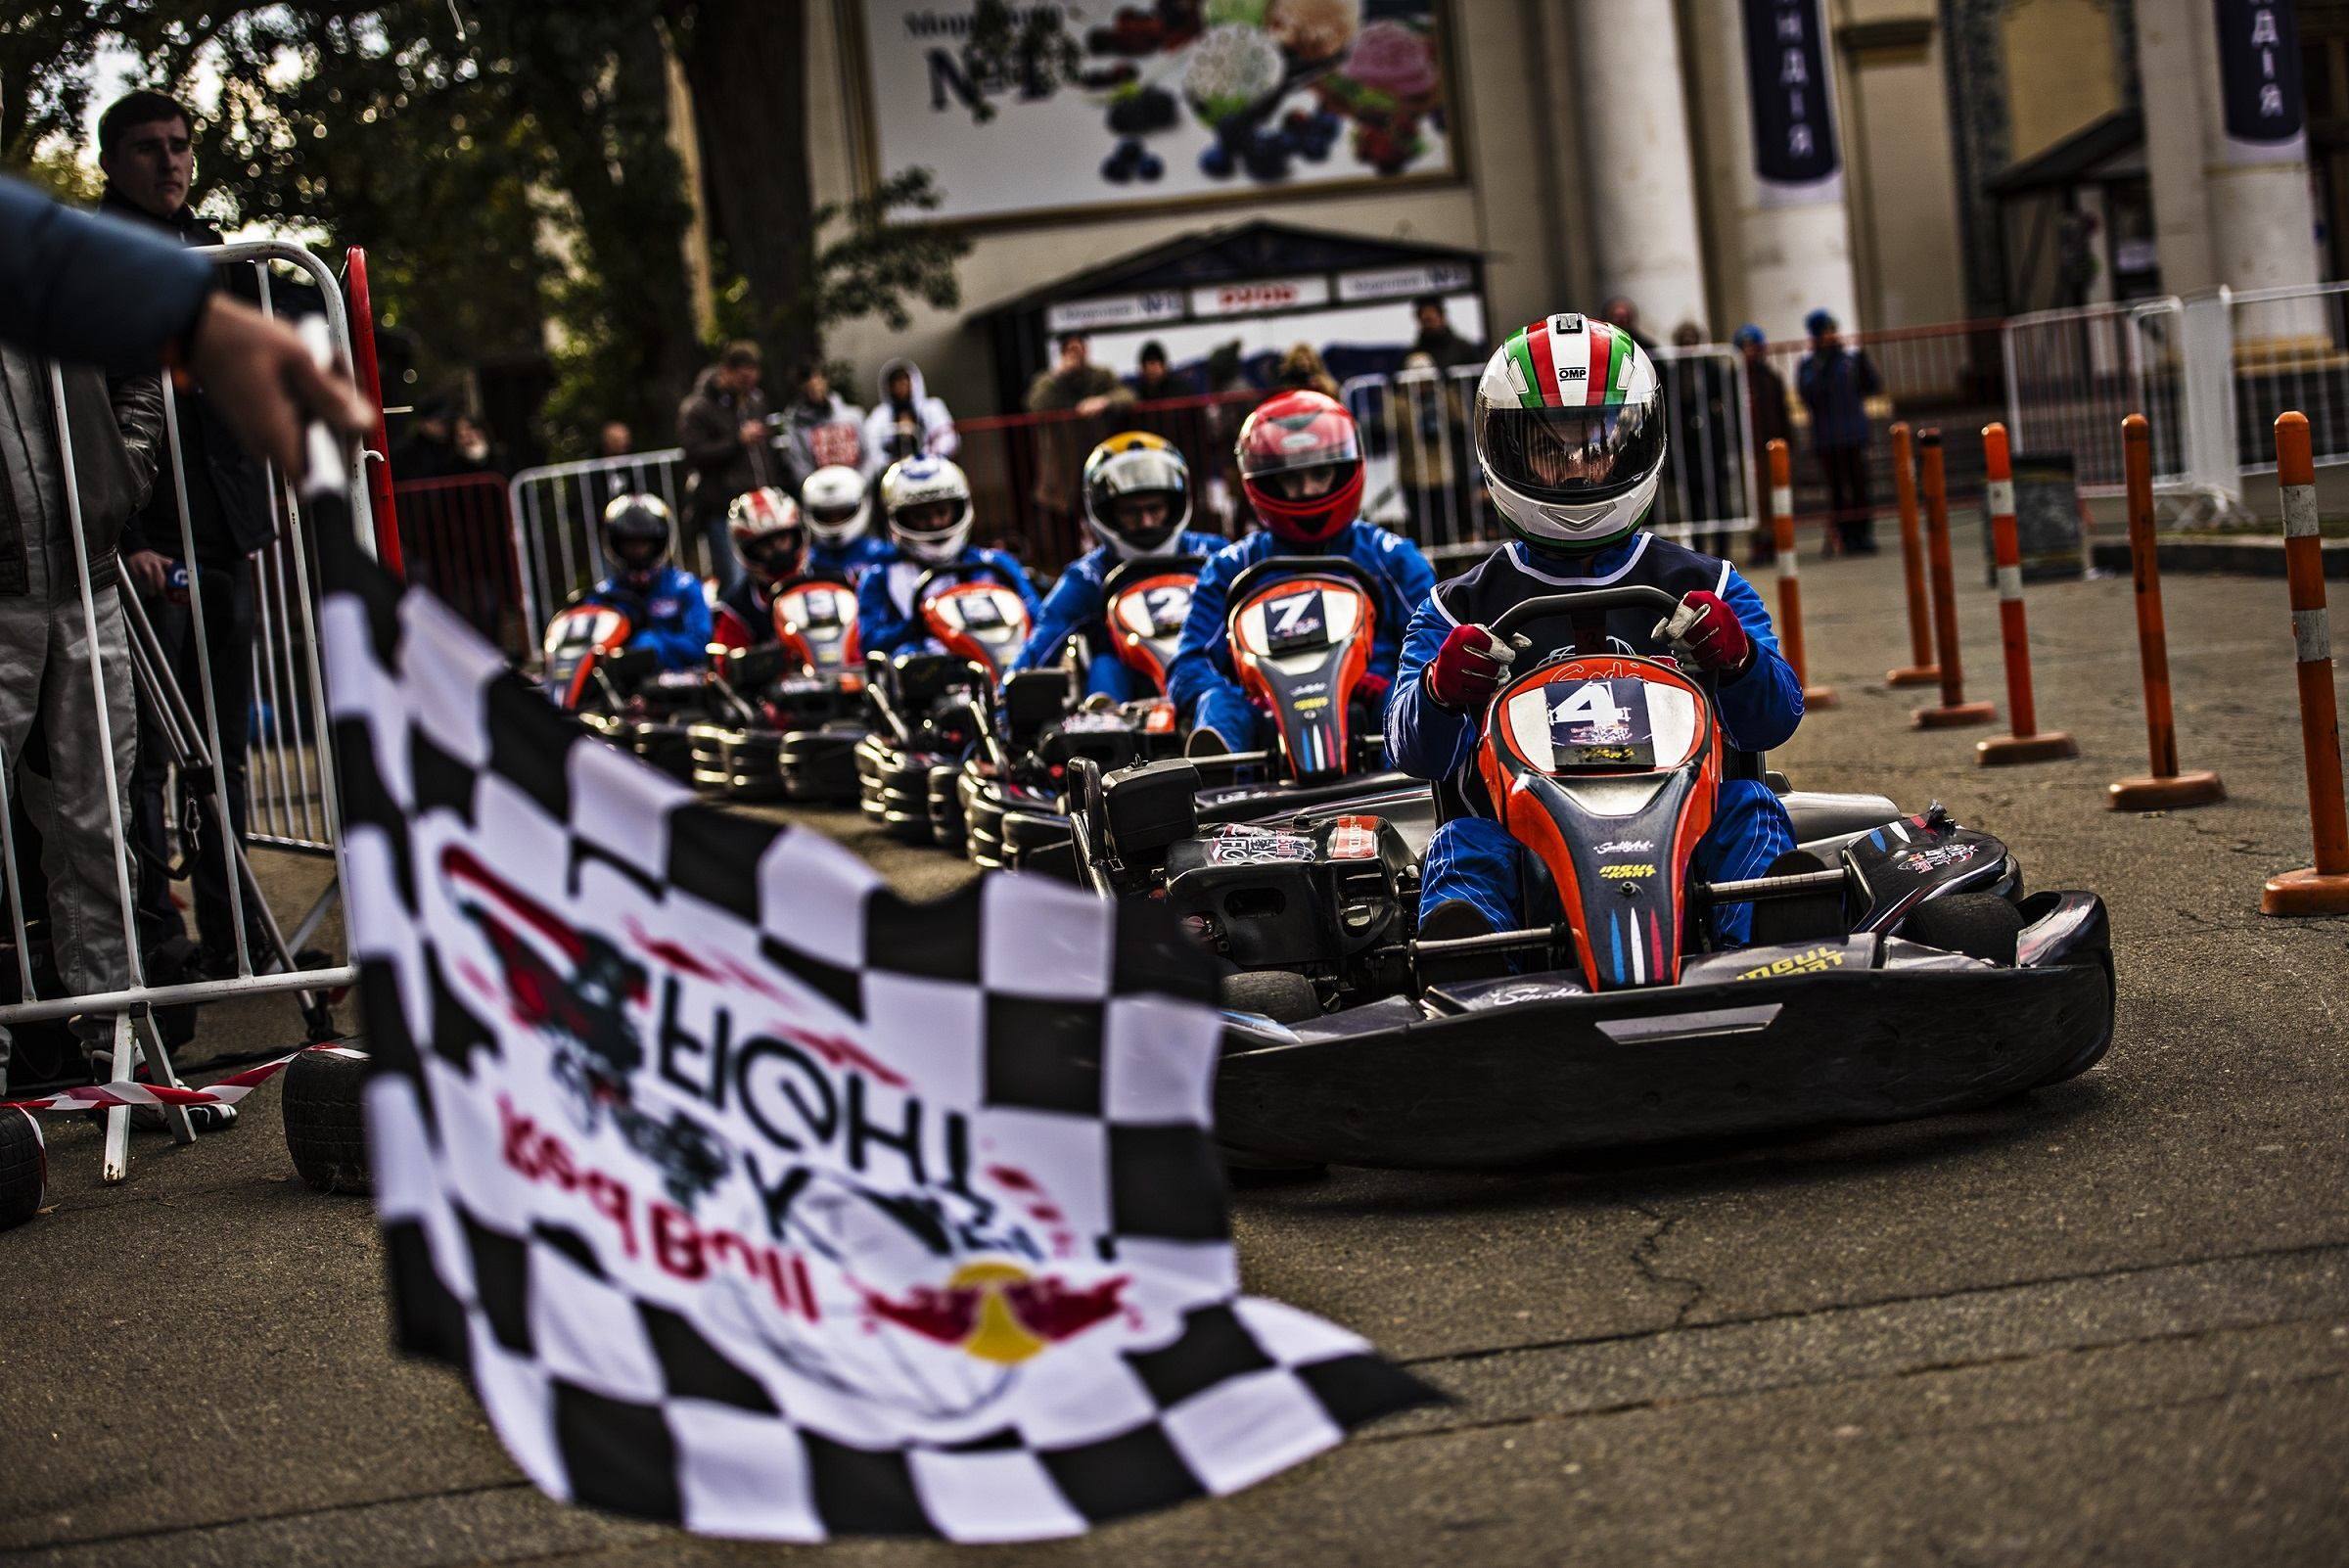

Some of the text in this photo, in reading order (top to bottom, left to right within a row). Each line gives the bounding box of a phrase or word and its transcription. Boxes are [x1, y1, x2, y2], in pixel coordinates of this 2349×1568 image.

[1558, 368, 1587, 380] OMP
[1146, 587, 1191, 621] 2
[1268, 590, 1317, 633] 7
[1548, 681, 1632, 725] 4
